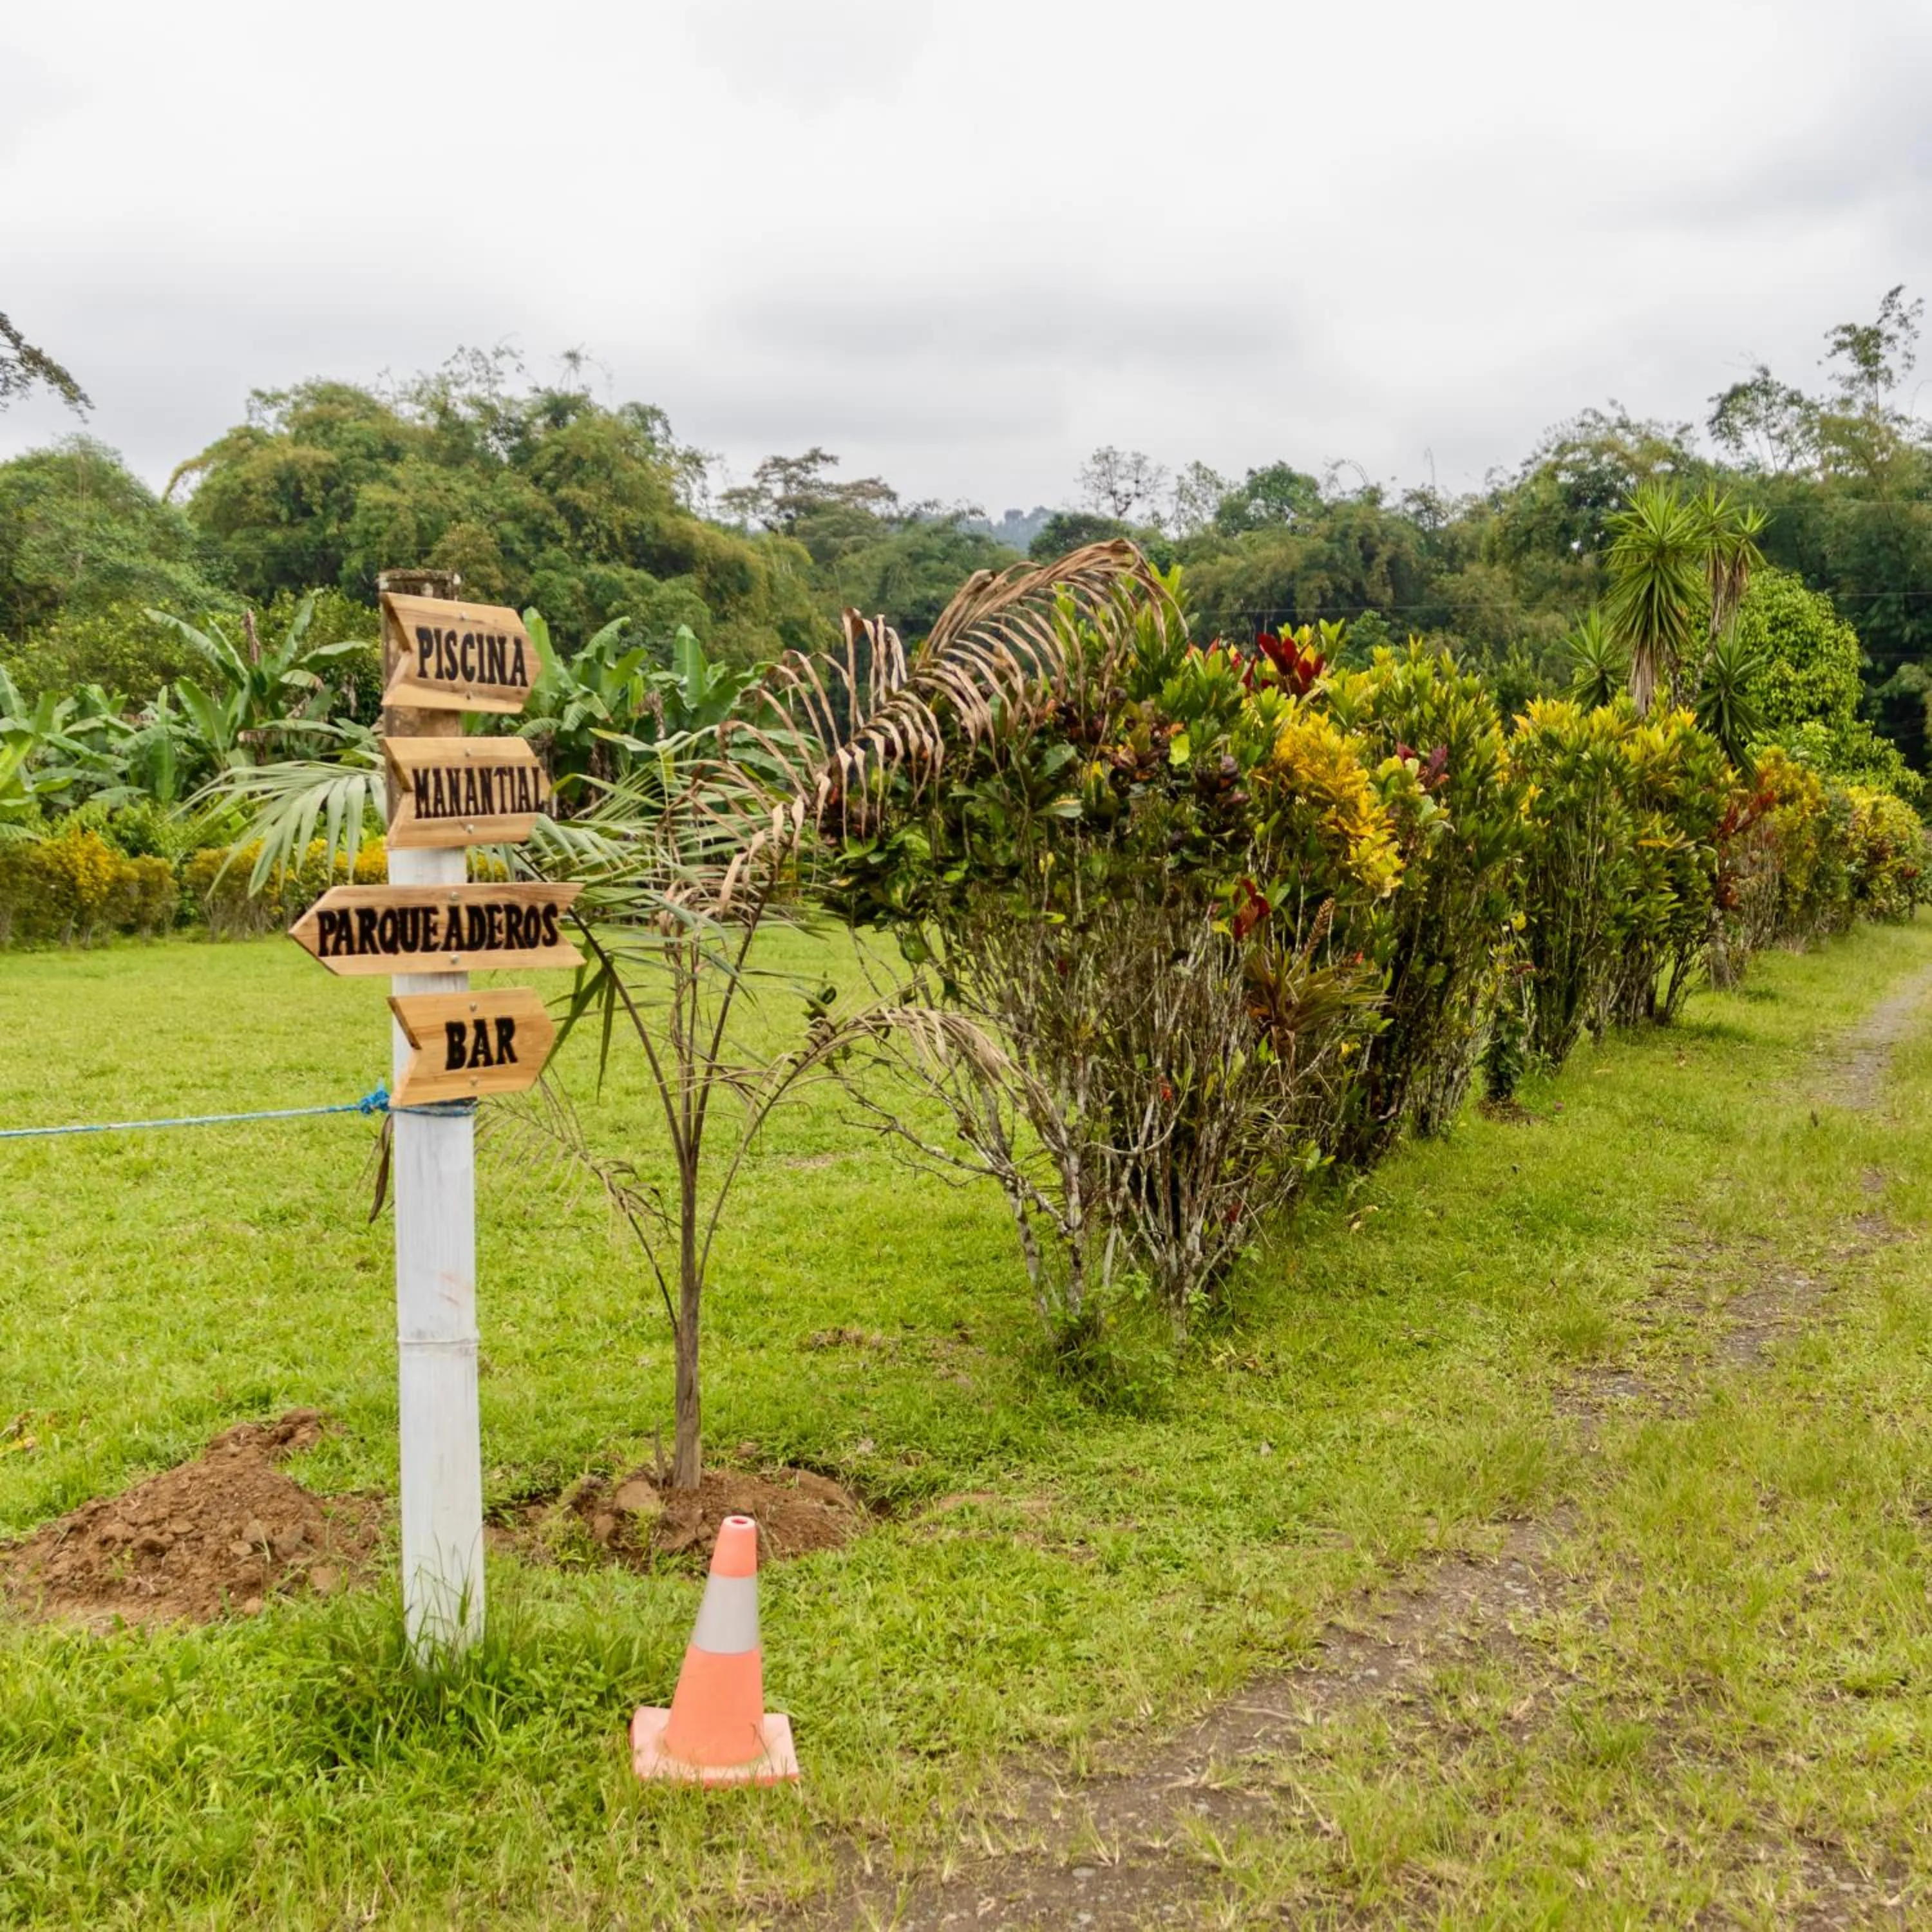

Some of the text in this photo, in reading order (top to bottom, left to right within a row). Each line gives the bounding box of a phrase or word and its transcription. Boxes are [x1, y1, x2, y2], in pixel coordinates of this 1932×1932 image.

[415, 626, 528, 687] PISCINA
[412, 766, 545, 819] MANANTIAL
[316, 902, 559, 957] PARQUEADEROS
[445, 1017, 518, 1071] BAR
